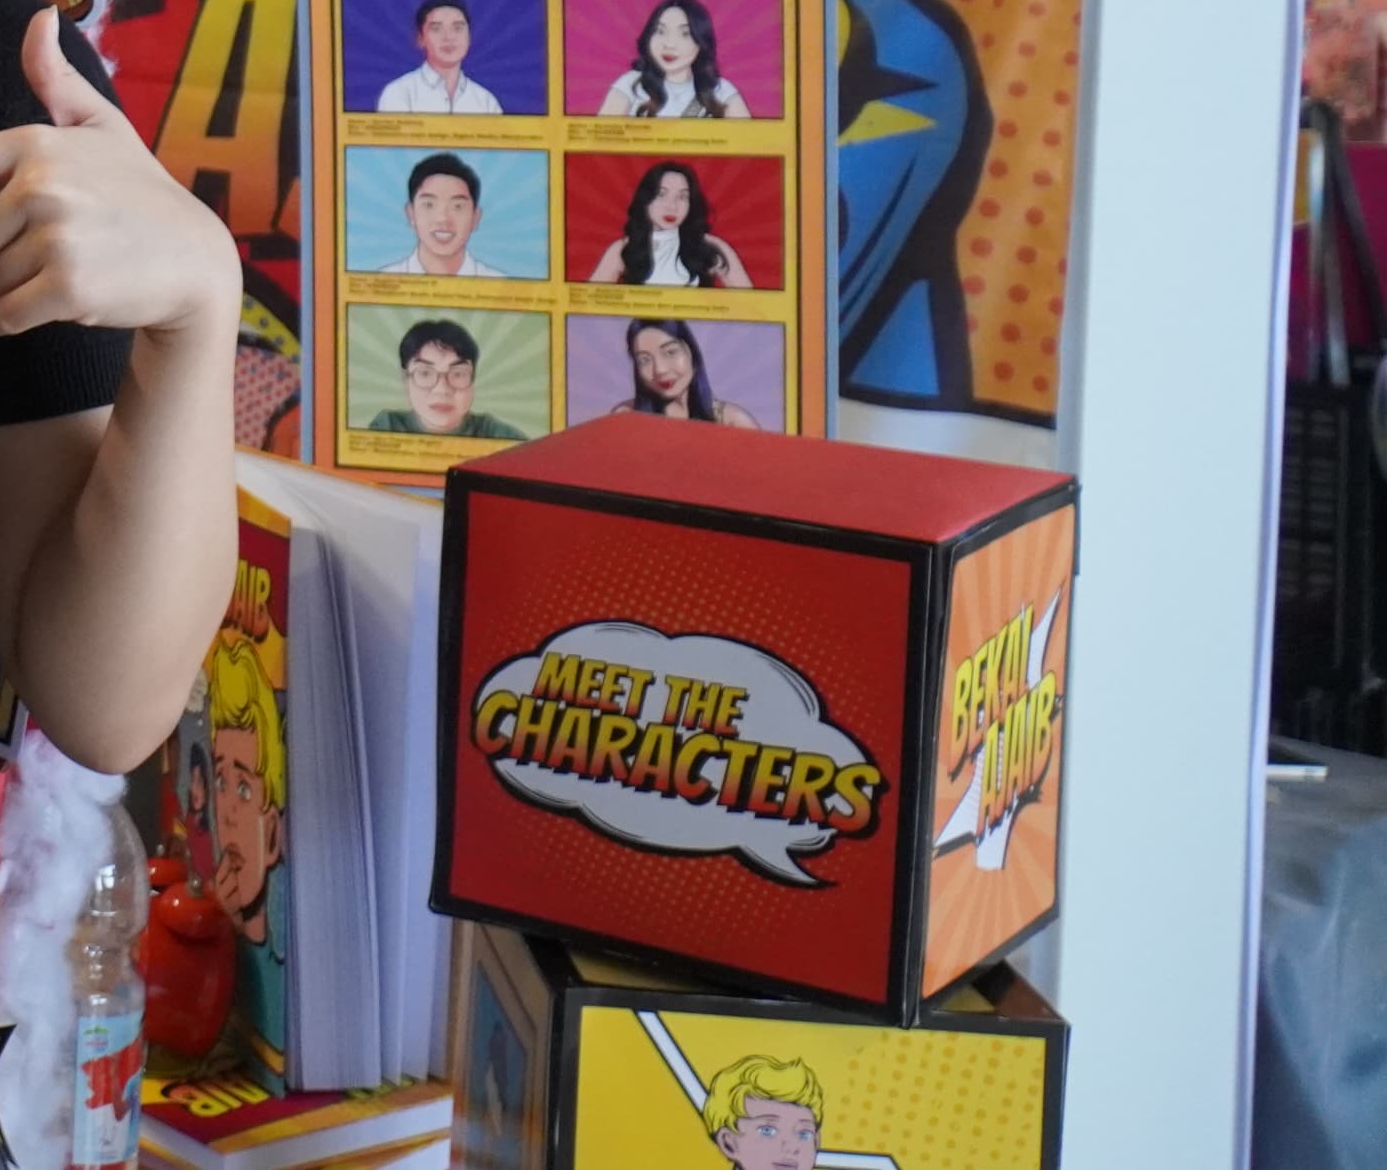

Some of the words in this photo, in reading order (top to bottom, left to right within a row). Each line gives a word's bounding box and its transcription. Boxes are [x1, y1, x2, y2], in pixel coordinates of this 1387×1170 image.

[475, 690, 885, 834] CHARACTERS
[533, 652, 657, 716] MEET
[663, 674, 749, 737] THE
[947, 604, 1034, 778] BEKAL
[977, 670, 1056, 838] AJAIB
